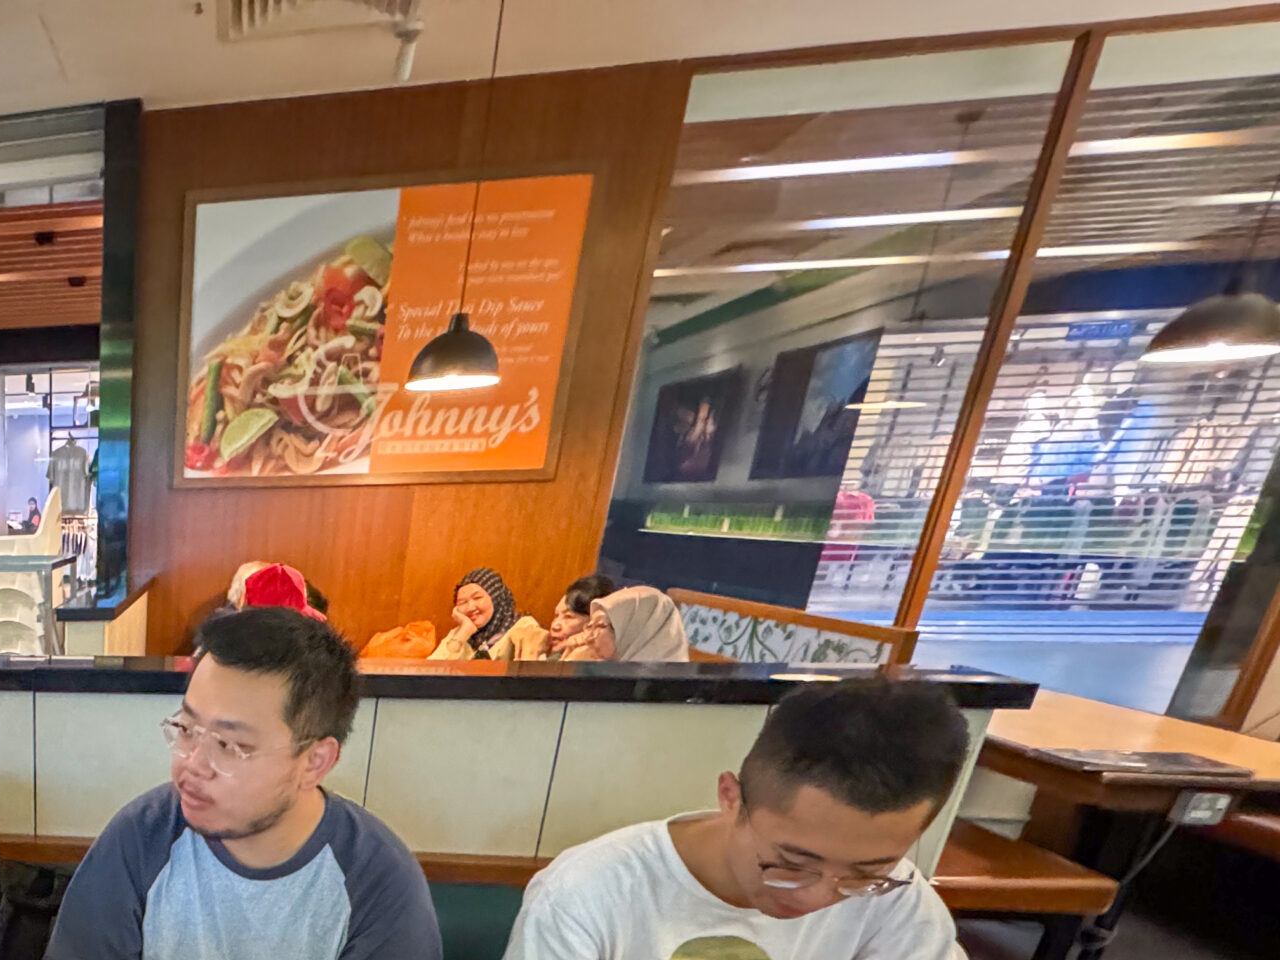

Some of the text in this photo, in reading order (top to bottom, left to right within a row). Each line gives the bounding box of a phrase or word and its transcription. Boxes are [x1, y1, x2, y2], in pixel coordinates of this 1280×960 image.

[399, 302, 442, 323] Special
[479, 299, 503, 317] Dip
[398, 324, 411, 341] To
[337, 385, 541, 464] Johnny's
